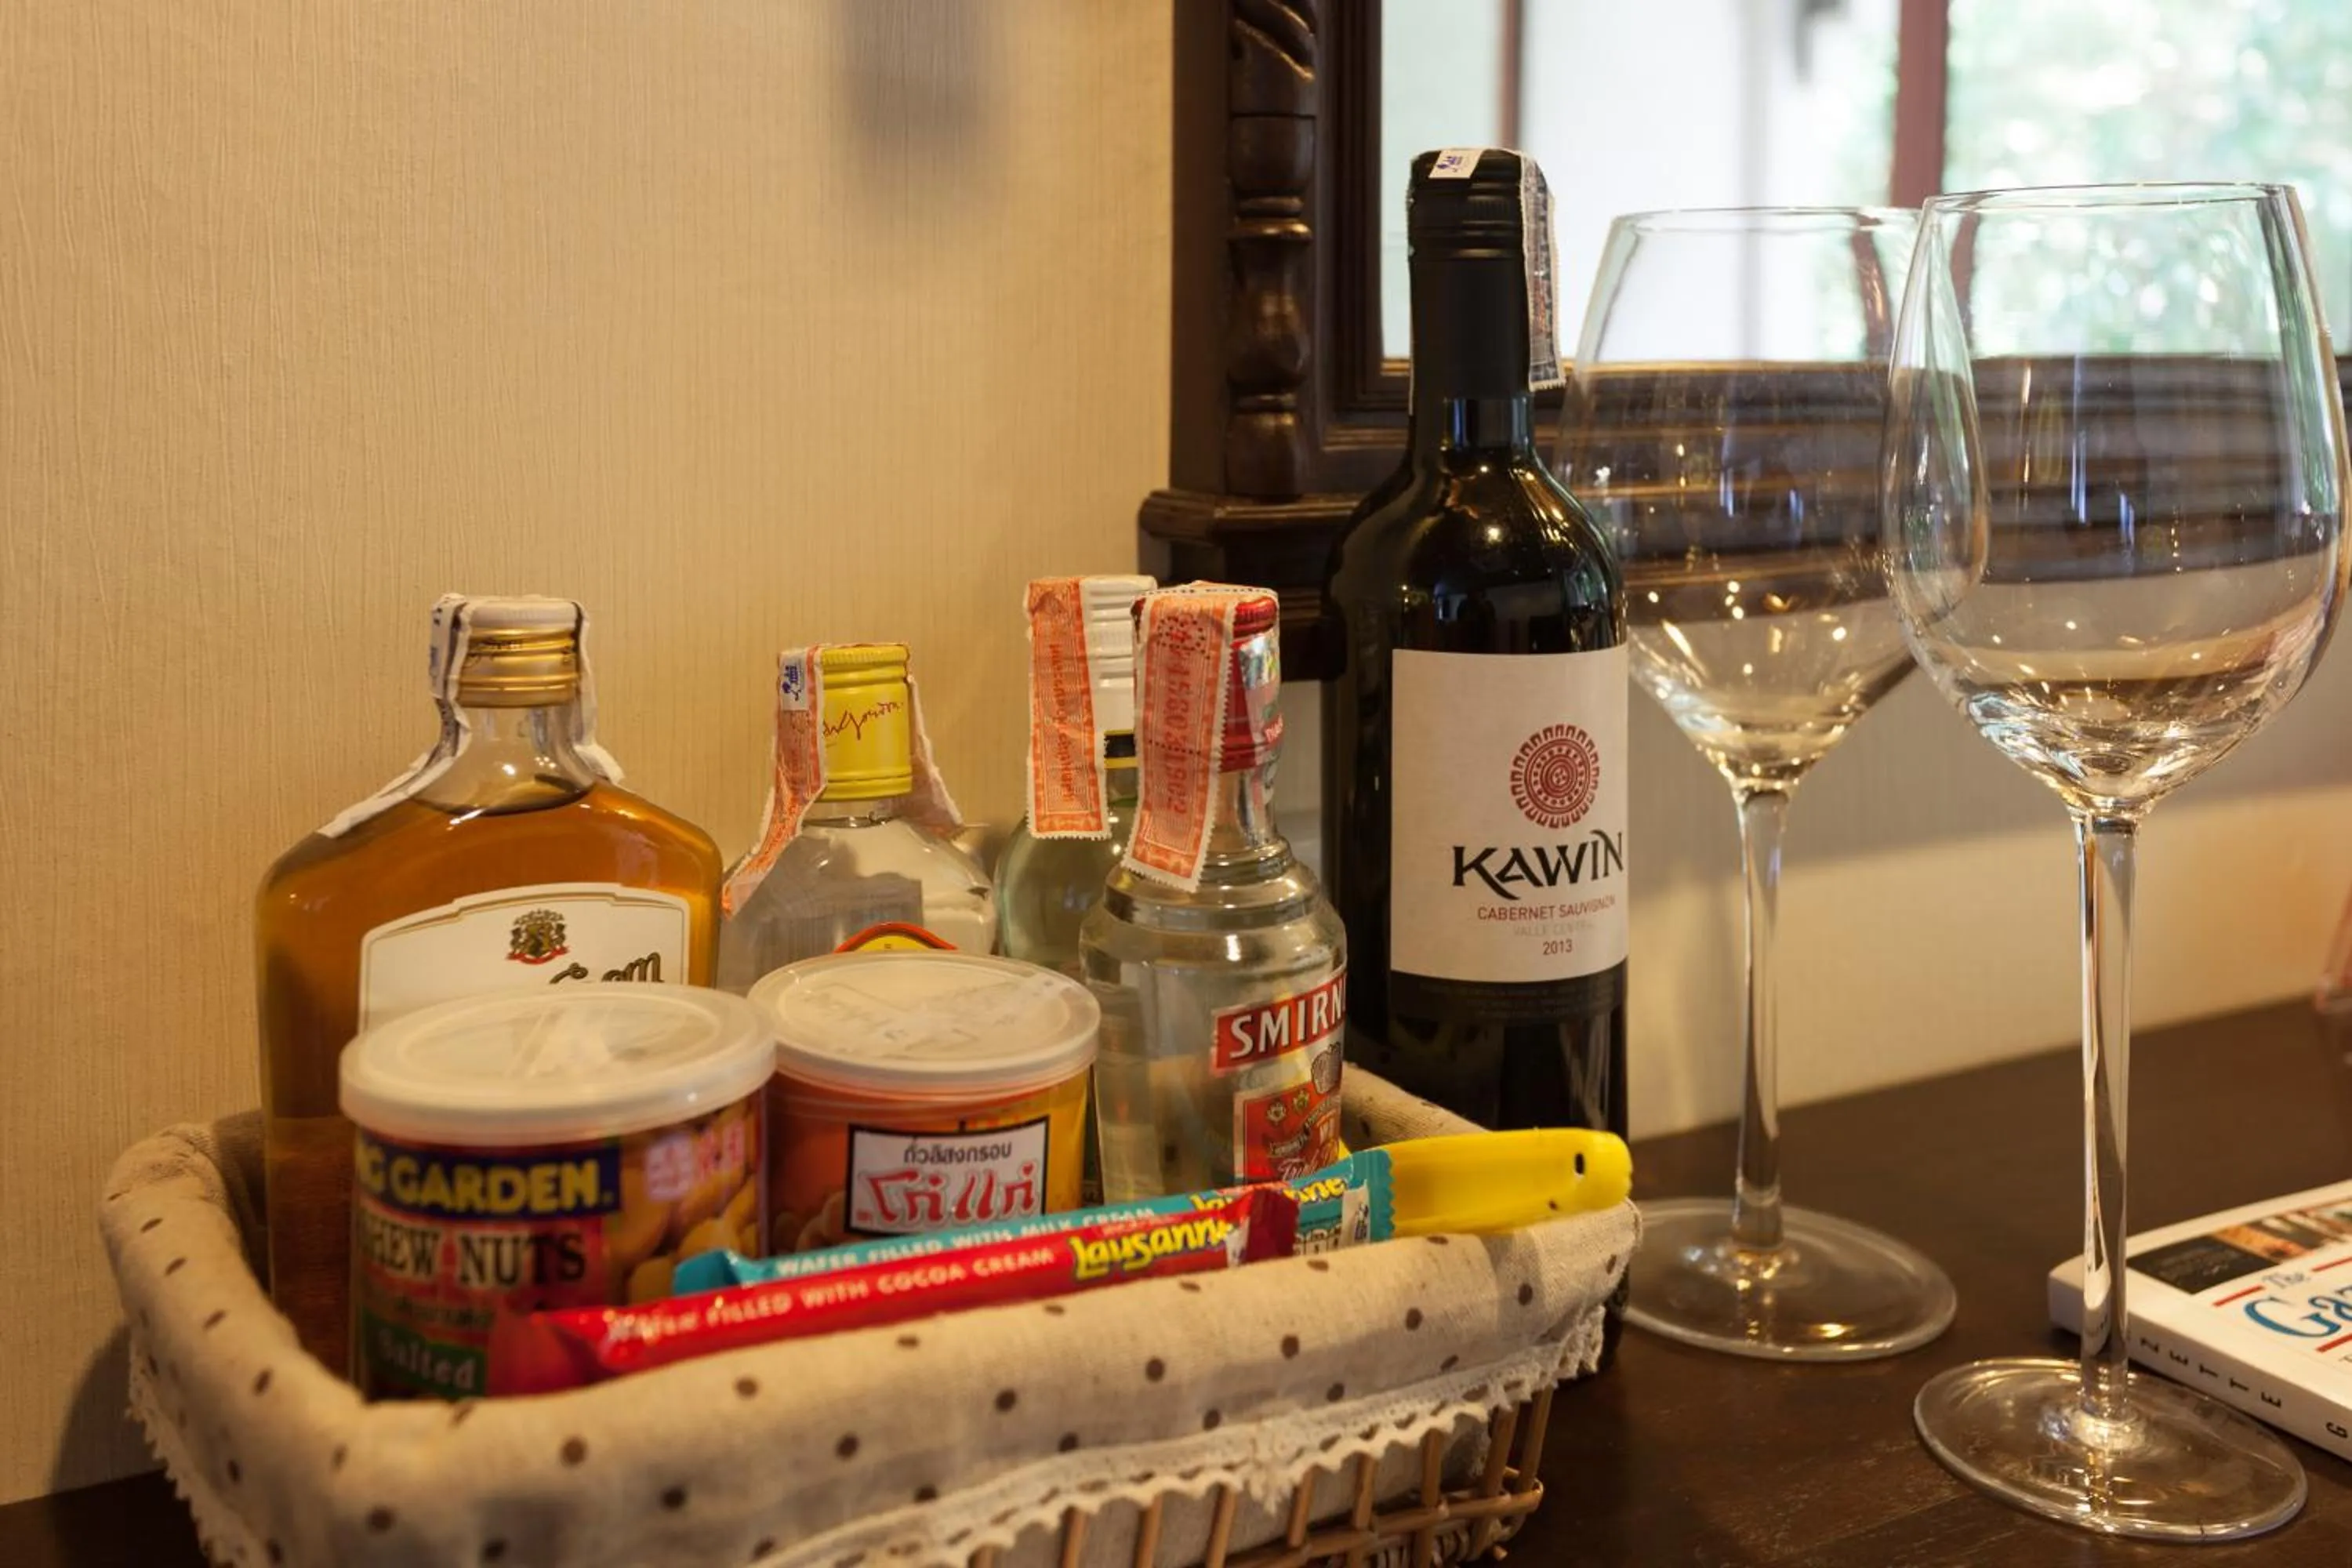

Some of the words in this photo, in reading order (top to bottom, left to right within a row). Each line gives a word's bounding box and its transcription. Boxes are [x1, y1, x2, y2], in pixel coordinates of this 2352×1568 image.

[1453, 829, 1624, 900] KAWIN
[1477, 905, 1555, 922] CABERNET
[1559, 894, 1616, 918] SAUVIGNON
[1543, 938, 1573, 956] 2013
[1229, 977, 1347, 1059] SMIRN
[459, 1232, 586, 1287] NUTS
[776, 1250, 858, 1276] WAFER
[952, 1228, 1013, 1249] WITH
[1021, 1218, 1072, 1237] MILK
[707, 1294, 793, 1327] FILLED
[800, 1279, 869, 1309] WITH
[877, 1263, 967, 1295] COCOA
[972, 1247, 1055, 1277] CREAM
[2244, 1284, 2352, 1338] Ga
